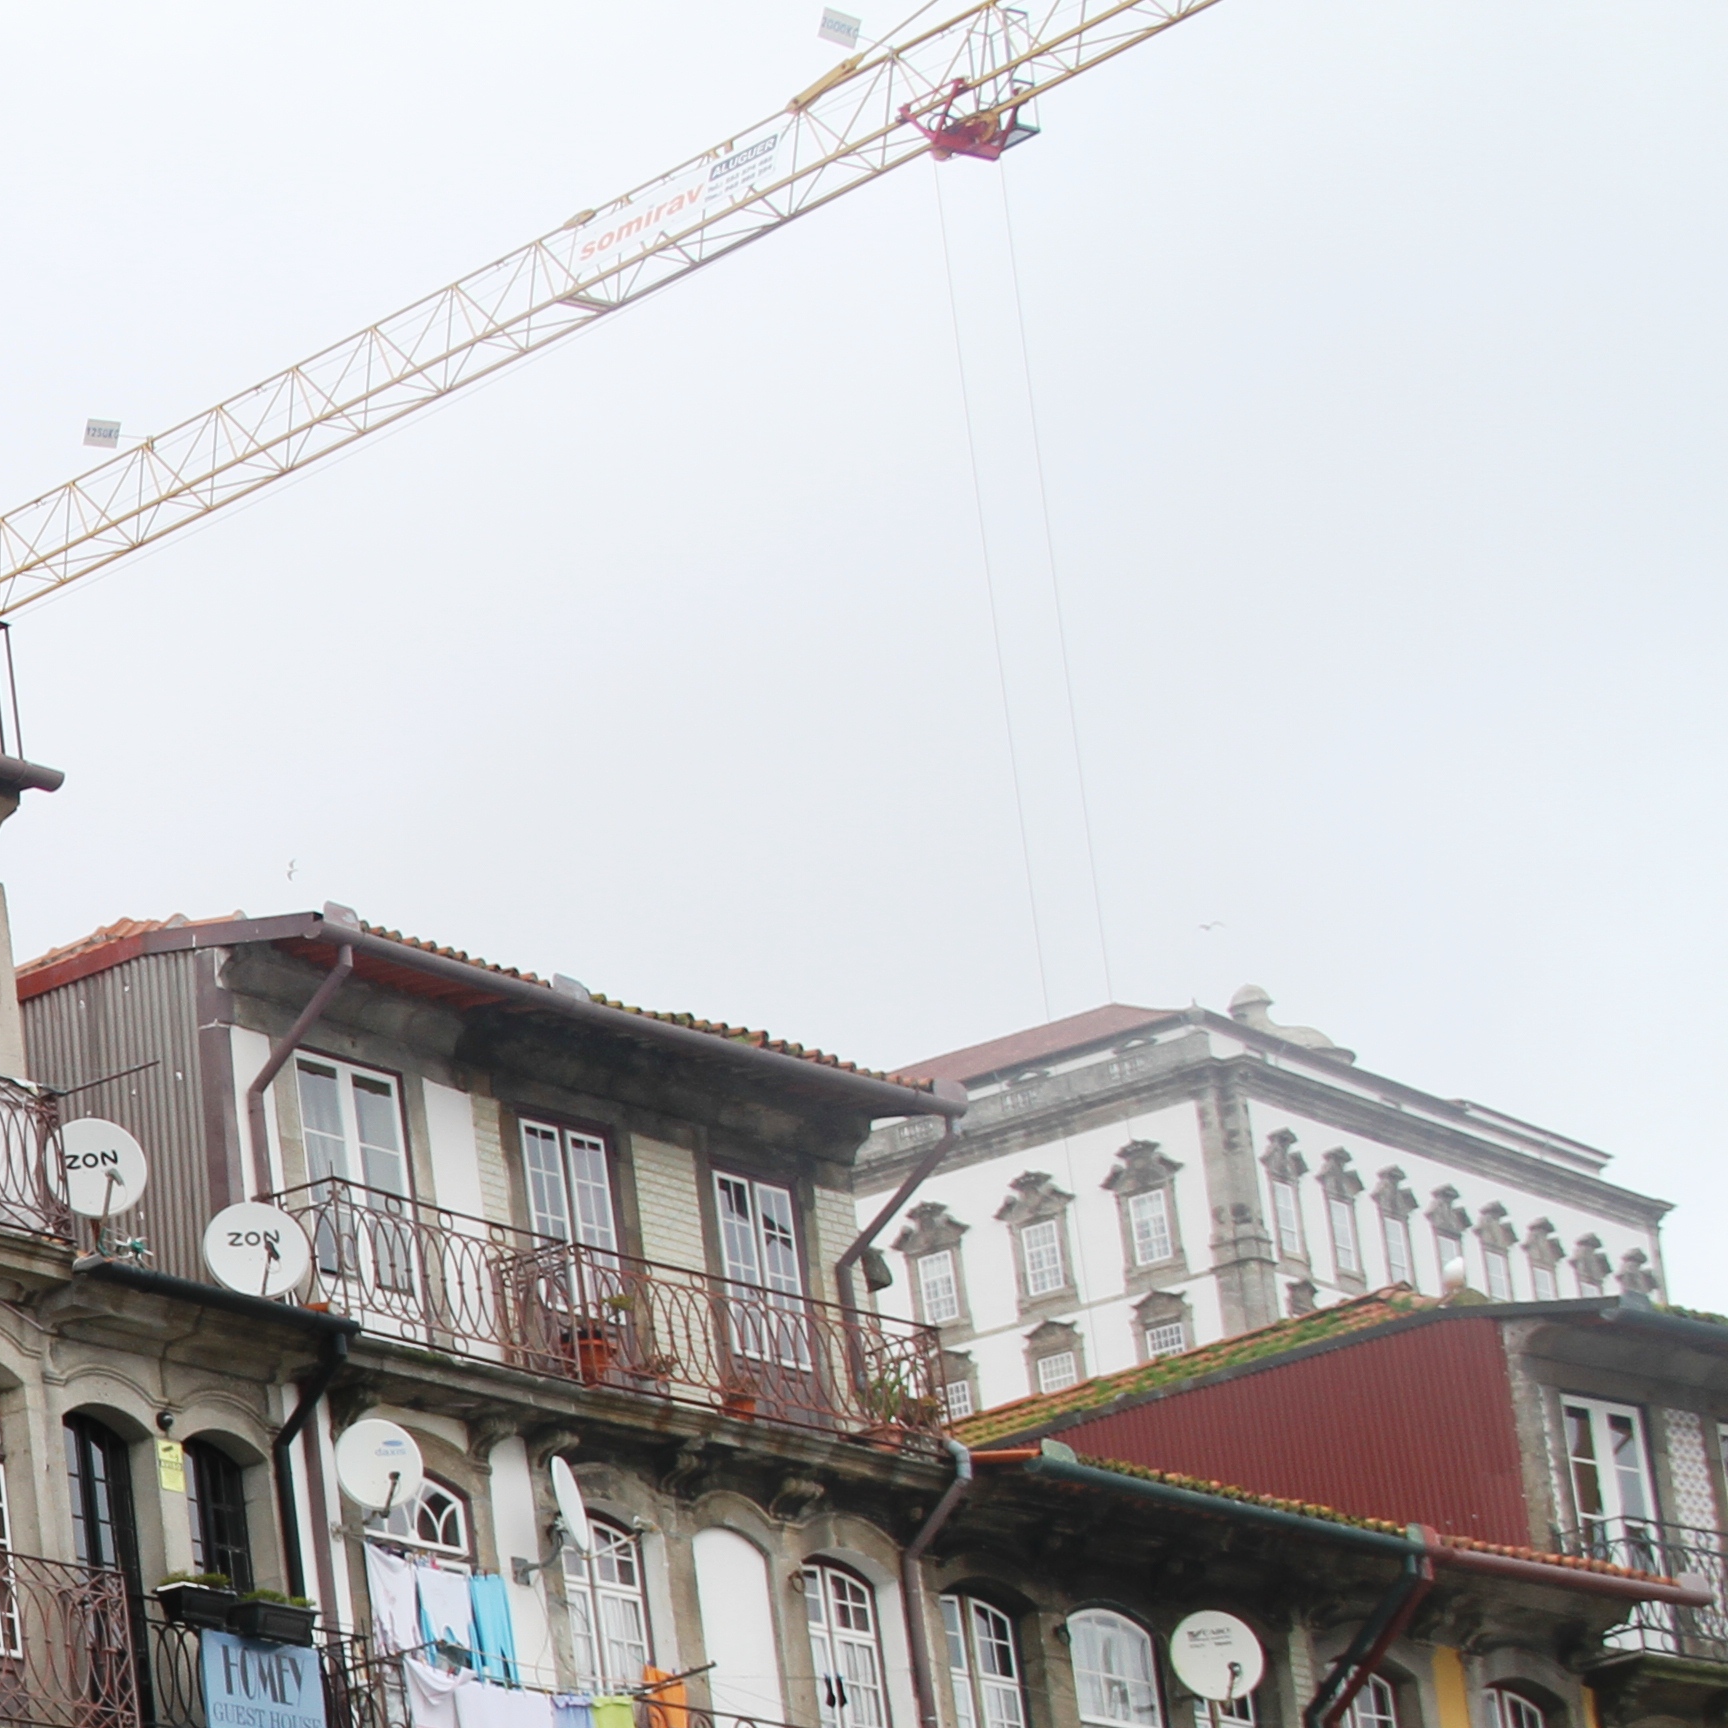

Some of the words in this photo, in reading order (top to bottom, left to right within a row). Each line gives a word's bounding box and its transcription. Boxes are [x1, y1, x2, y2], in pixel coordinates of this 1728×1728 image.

[711, 137, 775, 178] ALUGUER
[580, 184, 704, 261] somirav
[66, 1150, 118, 1169] ZON
[227, 1230, 280, 1247] ZON
[222, 1644, 303, 1707] HOMEY
[212, 1701, 266, 1728] GUEST
